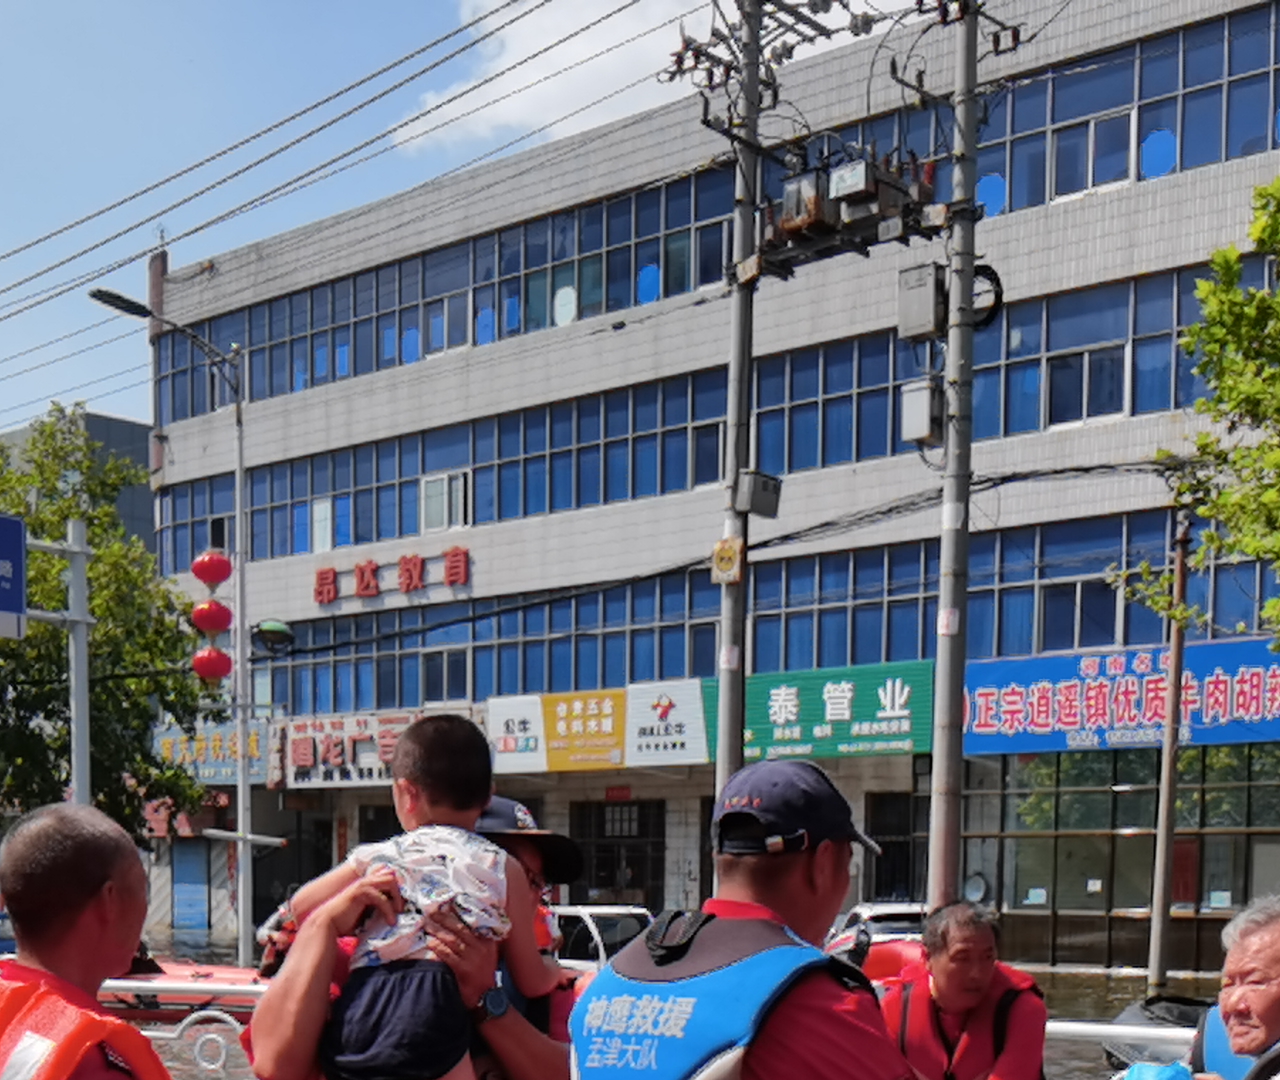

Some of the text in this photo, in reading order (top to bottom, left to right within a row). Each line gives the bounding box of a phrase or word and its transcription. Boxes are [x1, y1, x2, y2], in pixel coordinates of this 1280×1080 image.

[313, 546, 469, 603] 昂达教育
[583, 993, 697, 1039] 神鹰救援
[585, 1036, 658, 1070] 孟津大队
